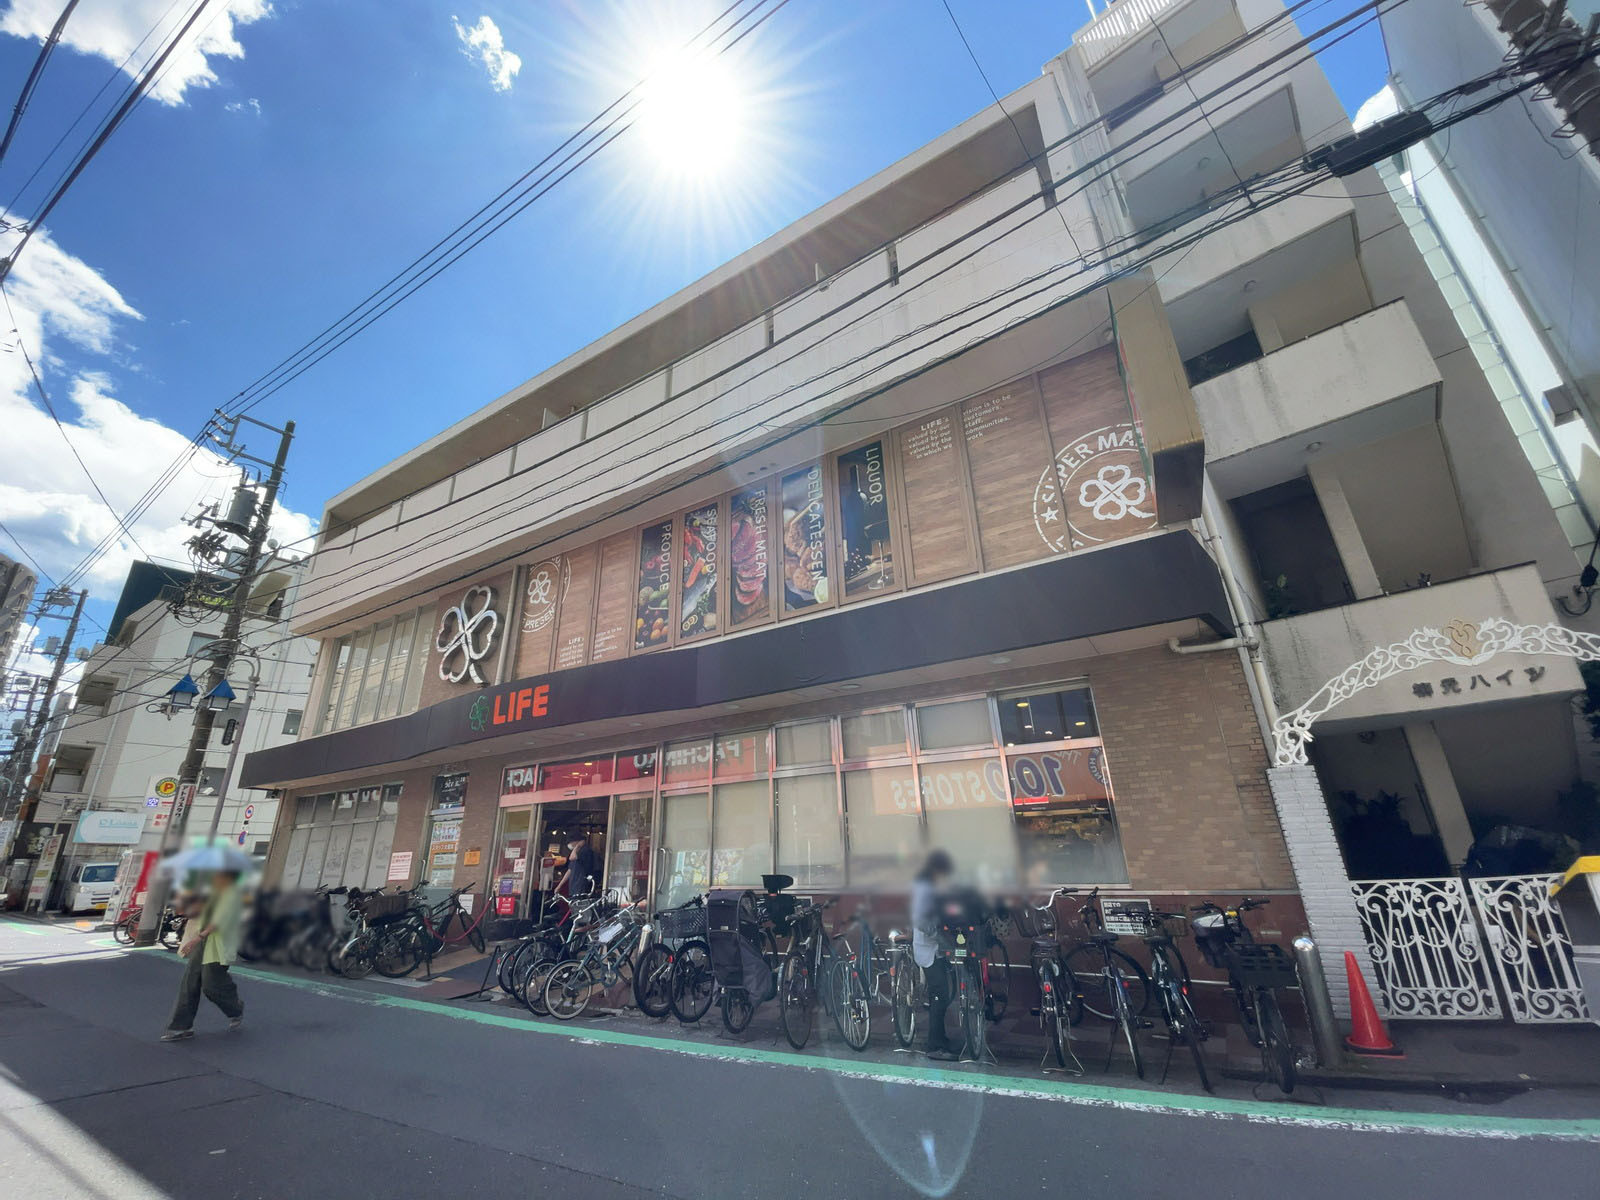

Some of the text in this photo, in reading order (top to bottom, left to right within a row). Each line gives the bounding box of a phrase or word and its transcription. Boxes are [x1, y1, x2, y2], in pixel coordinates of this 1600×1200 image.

[865, 447, 883, 506] LIQUOR
[660, 523, 672, 591] PRODUCE
[705, 509, 717, 573] SEAFOOD
[755, 489, 767, 579] FRESH MEAT
[807, 470, 825, 581] DELICATESSEN
[493, 684, 550, 725] LIFE
